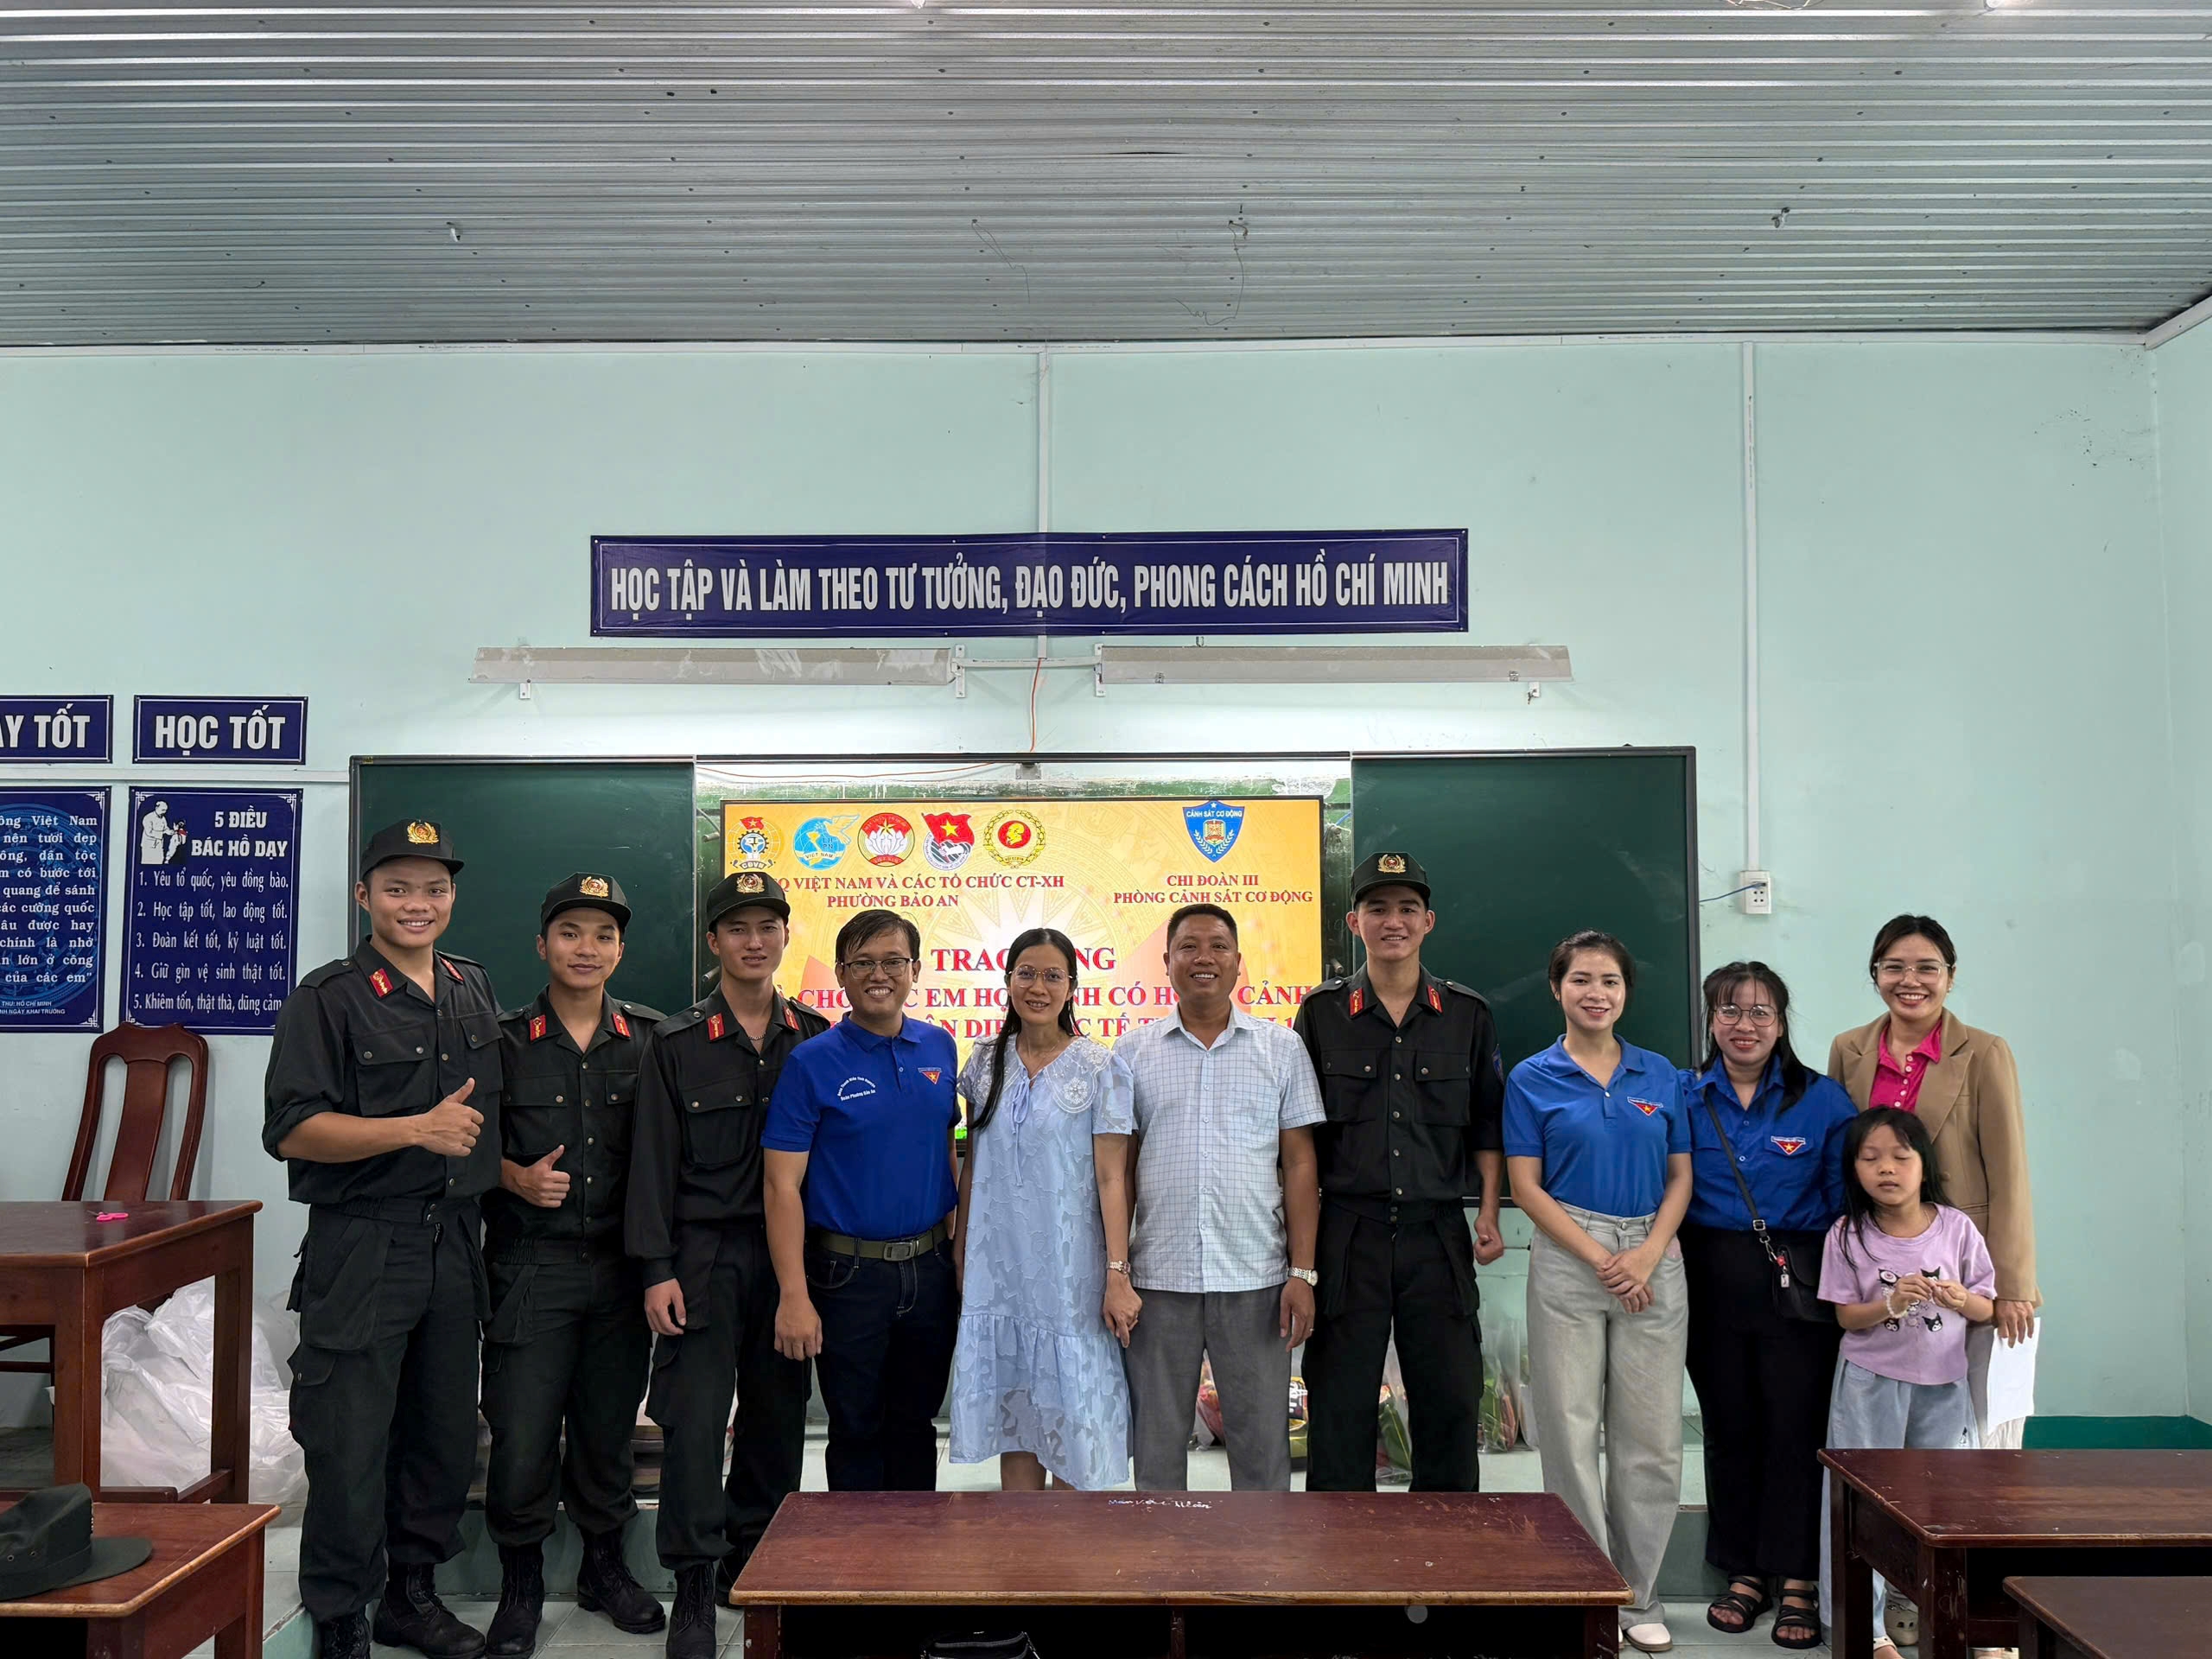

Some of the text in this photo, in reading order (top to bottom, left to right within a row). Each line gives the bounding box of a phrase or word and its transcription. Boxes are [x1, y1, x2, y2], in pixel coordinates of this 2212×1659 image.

[611, 549, 1449, 620] HỌC TẬP VÀ LÀM THEO TƯ TƯỞNG, ĐẠO ĐỨC, PHONG CÁCH HỒ CHÍ MINH
[34, 702, 91, 748] TỐT
[155, 704, 286, 756] HỌC TỐT
[31, 816, 59, 828] Việt
[69, 816, 98, 826] Nam
[214, 805, 267, 829] 5 ĐIỀU
[3, 833, 28, 843] nên
[38, 832, 63, 843] tươi
[39, 850, 63, 861] dân
[75, 850, 97, 862] tộc
[191, 834, 288, 860] BÁC HỒ DẠY
[17, 868, 32, 878] có
[40, 868, 70, 878] bước
[78, 868, 96, 878] tới
[139, 867, 289, 893] 1. Yêu tổ quốc, yêu đồng bào.
[793, 873, 830, 892] VIỆT
[836, 876, 873, 889] NAM
[876, 873, 899, 888] VÀ
[906, 873, 936, 889] CÁC
[965, 872, 1012, 888] CHỨC
[1015, 875, 1065, 887] CT-XH
[1166, 872, 1259, 886] CHI ĐOÀN III
[3, 881, 95, 899] quang để sánh
[1114, 888, 1313, 905] PHÒNG CẢNH SÁT CƠ ĐỘNG
[22, 902, 60, 916] cường
[64, 900, 95, 915] quốc
[827, 892, 959, 908] PHƯỜNG BẢO AN
[137, 899, 288, 924] 2. Học tập tốt, lao động tốt.
[28, 919, 60, 932] được
[71, 919, 94, 932] hay
[0, 937, 93, 947] chính là nhờ
[136, 929, 286, 953] 3. Đoàn kết tốt, kỷ luật tốt.
[18, 955, 38, 965] lớn
[47, 953, 55, 965] ở
[63, 955, 93, 968] công
[5, 971, 28, 982] của
[36, 972, 58, 982] các
[134, 961, 286, 984] 4. Giữ gìn vệ sinh thật tốt.
[133, 995, 143, 1009] 5.
[145, 993, 174, 1009] Khiêm
[176, 990, 194, 1012] tốn,
[196, 994, 215, 1014] thật
[218, 994, 235, 1013] thà,
[238, 995, 260, 1015] dũng
[925, 988, 967, 1007] EM
[1109, 981, 1147, 1006] CÓ
